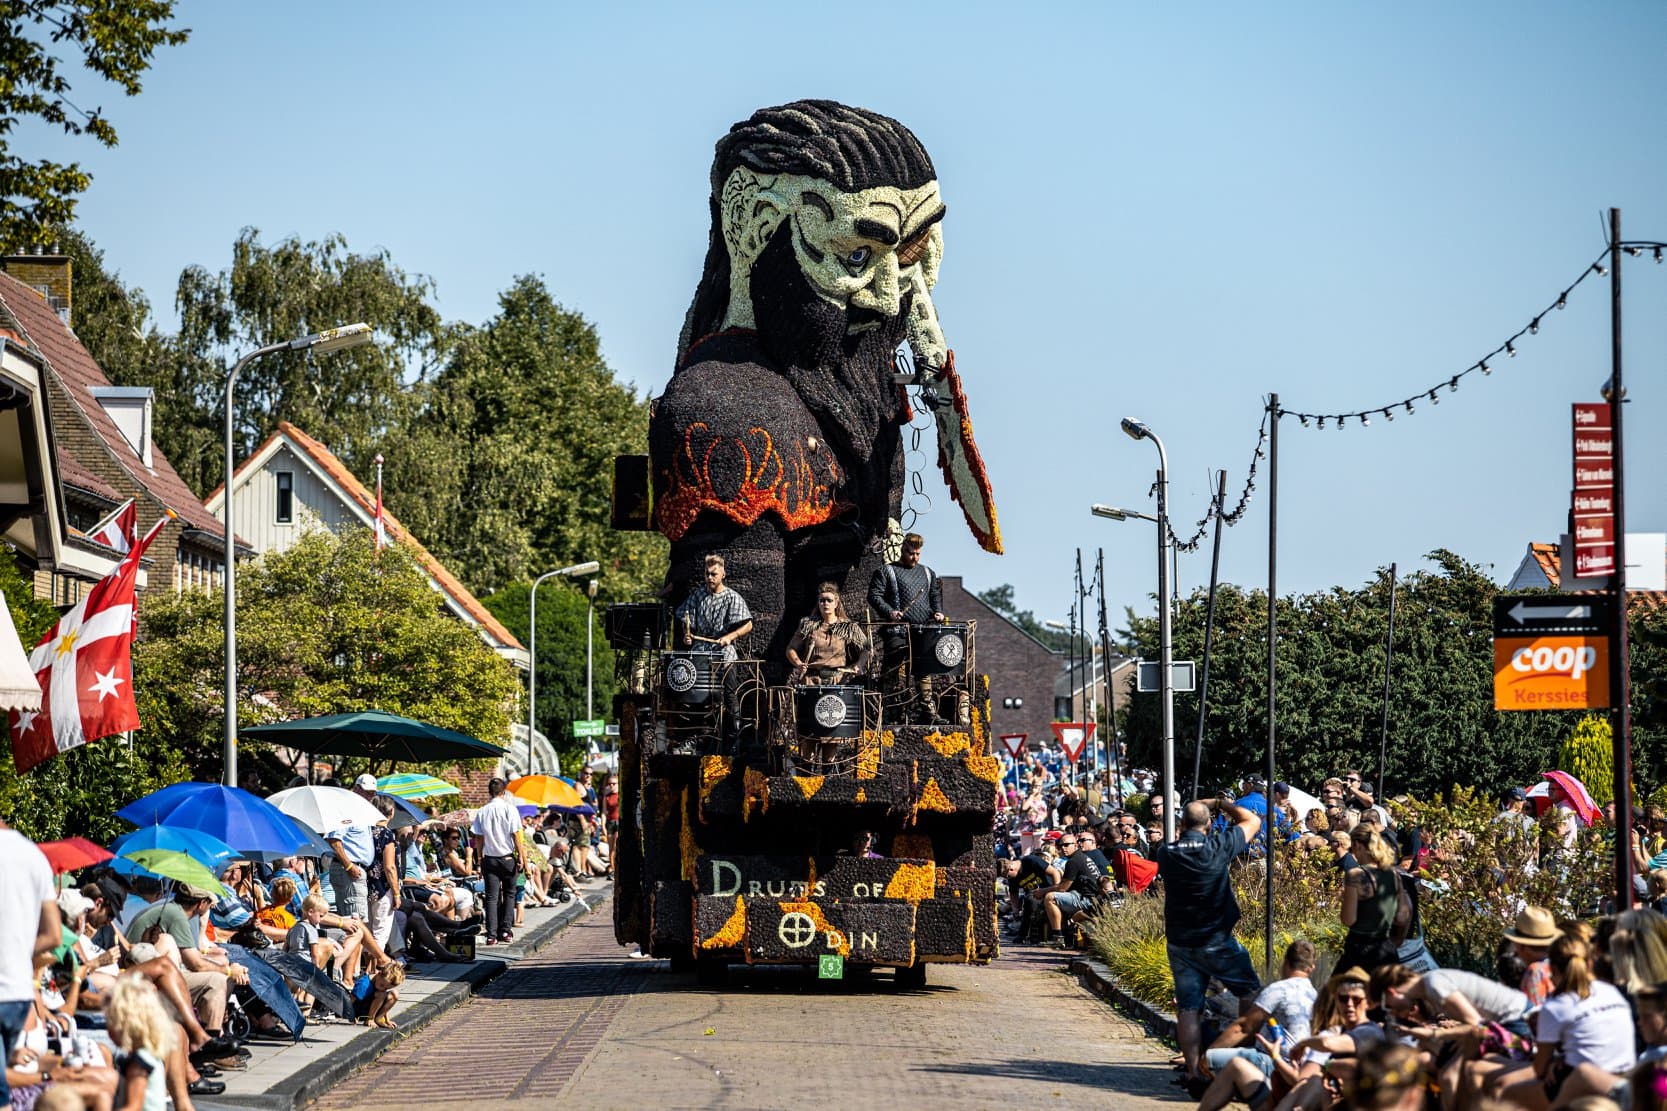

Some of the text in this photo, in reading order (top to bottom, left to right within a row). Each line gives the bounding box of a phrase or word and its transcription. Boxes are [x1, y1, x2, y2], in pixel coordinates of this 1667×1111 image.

[1511, 646, 1597, 680] coop
[1514, 688, 1590, 703] Kerssies
[853, 883, 884, 898] OF
